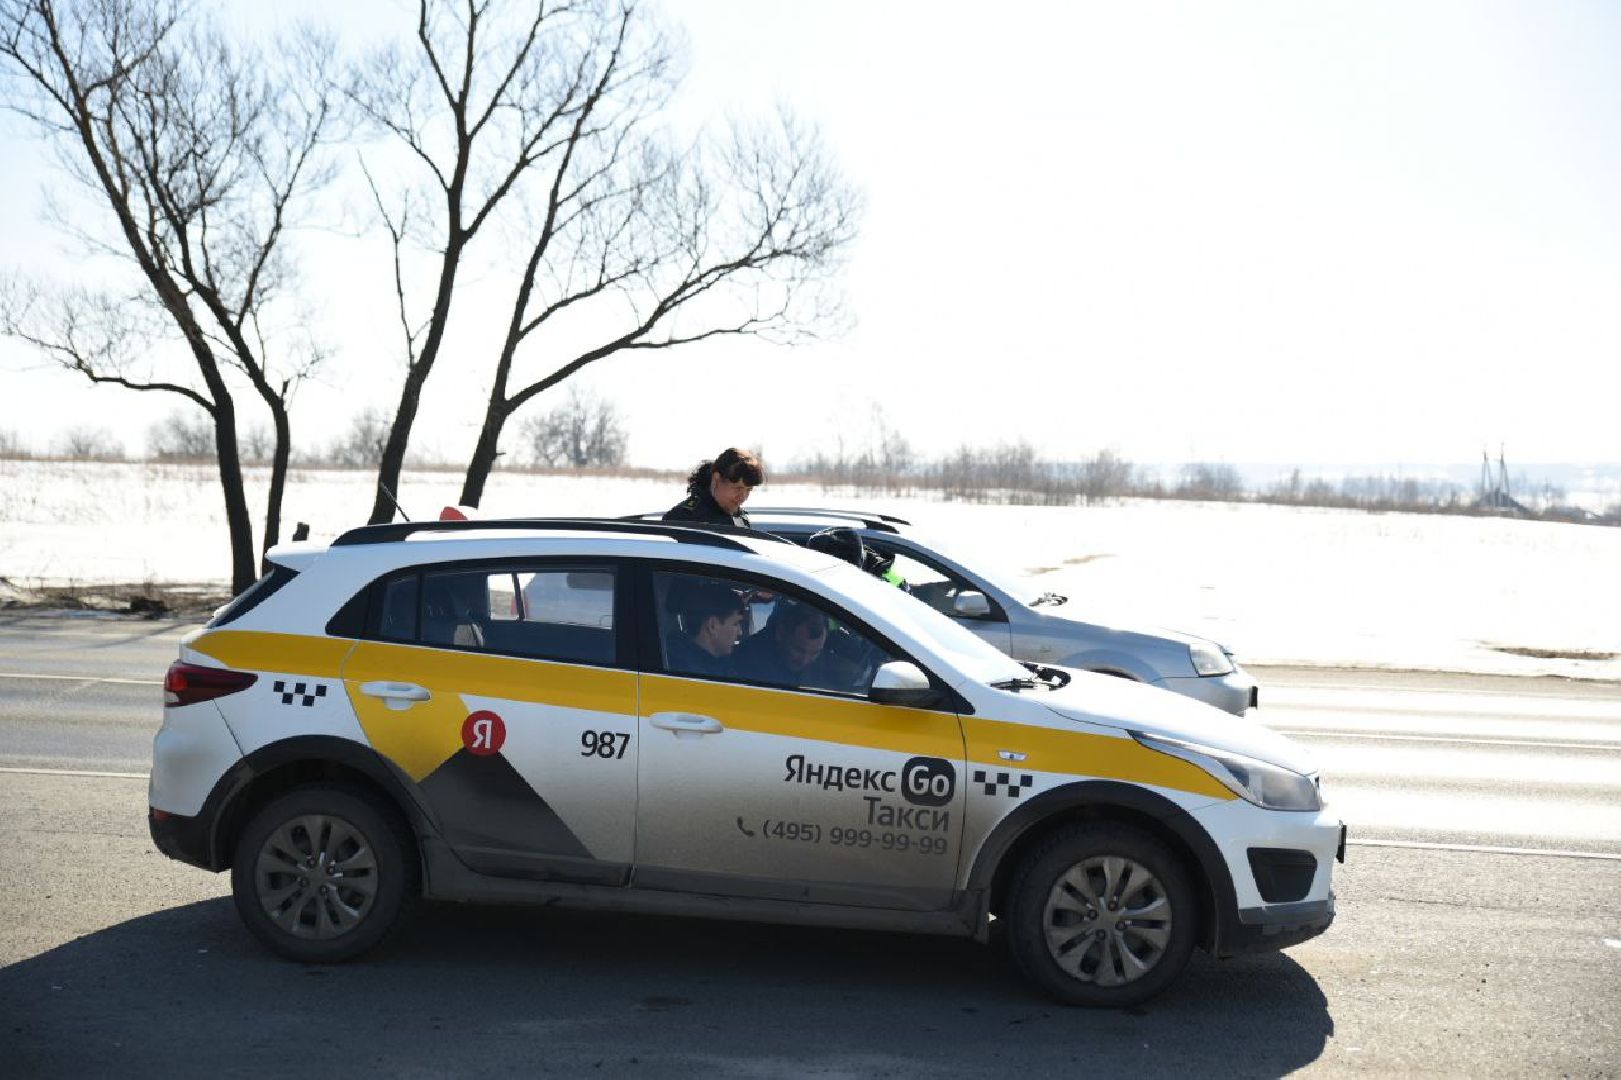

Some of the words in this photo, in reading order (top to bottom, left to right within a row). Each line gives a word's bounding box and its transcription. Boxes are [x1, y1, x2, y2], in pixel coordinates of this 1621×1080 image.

[472, 719, 492, 749] Я
[580, 729, 631, 759] 987
[784, 754, 897, 792] Яндекс
[908, 766, 950, 797] Go
[863, 796, 950, 832] Такси
[762, 819, 822, 844] (495)
[829, 826, 948, 855] 999-99-99
